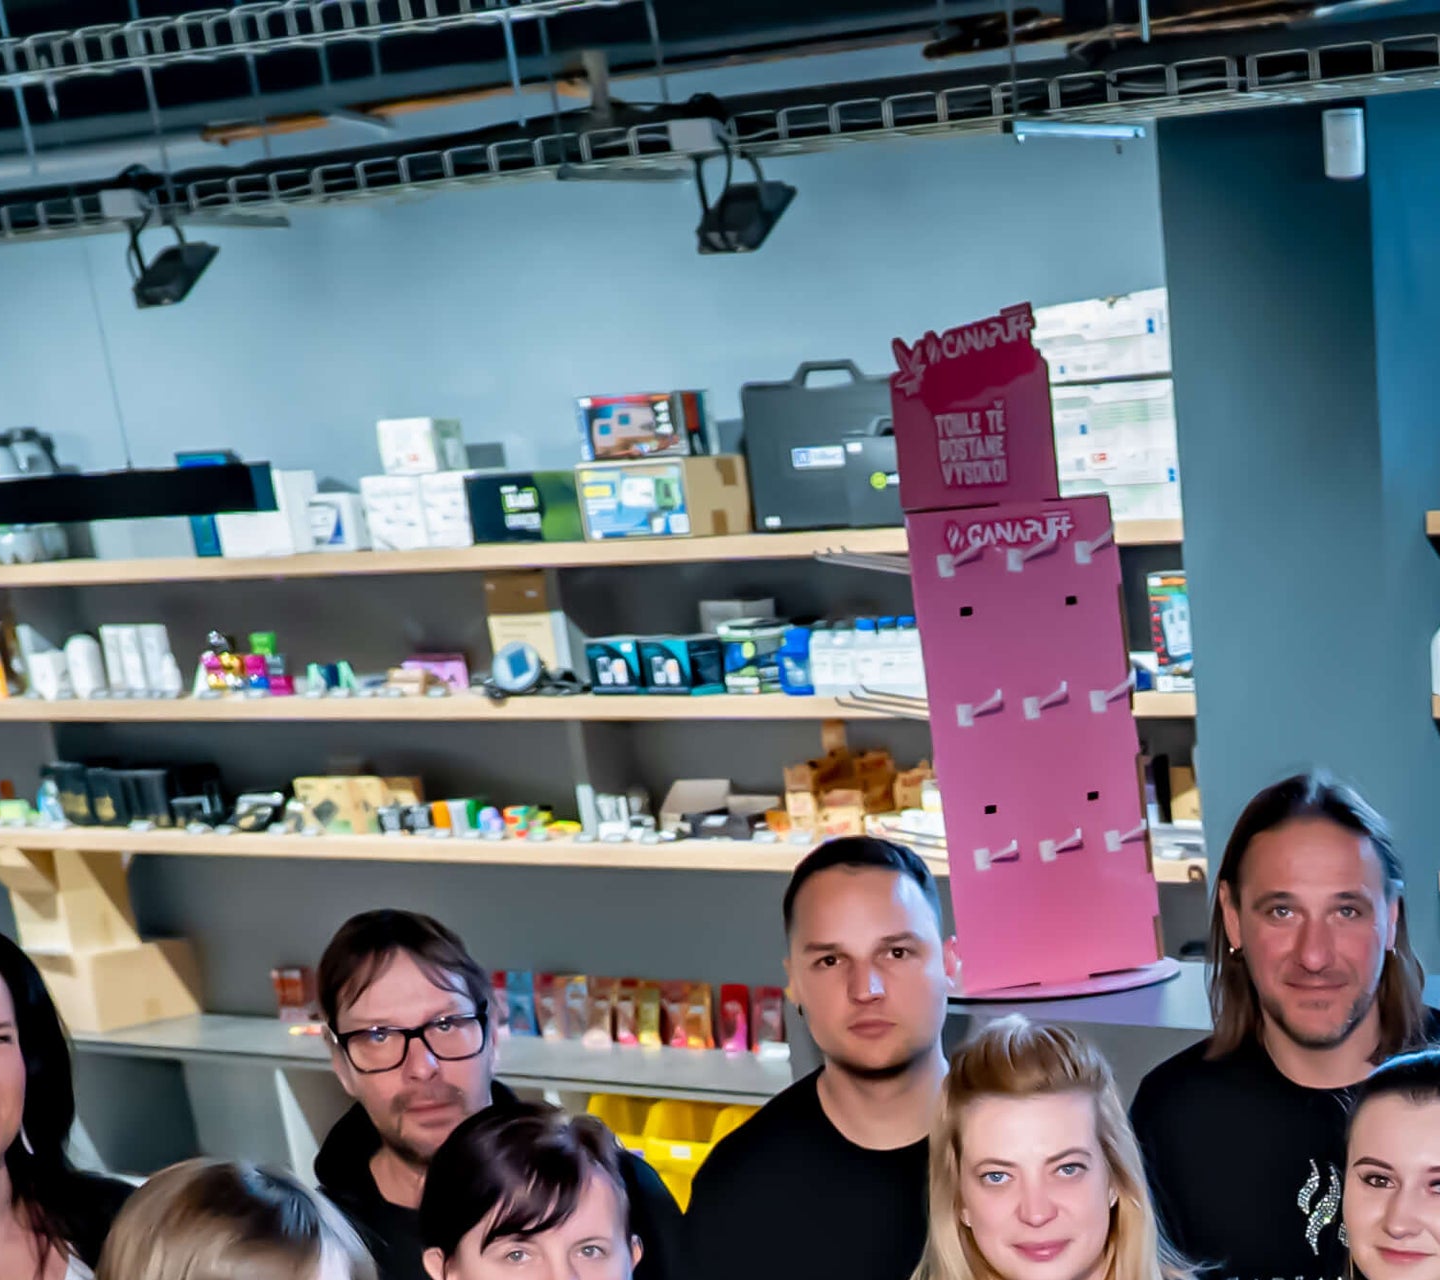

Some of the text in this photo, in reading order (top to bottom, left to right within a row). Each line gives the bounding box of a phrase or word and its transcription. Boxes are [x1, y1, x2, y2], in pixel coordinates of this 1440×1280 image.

[941, 312, 1032, 359] CANAPUFF
[935, 412, 981, 437] TOHLE
[938, 434, 1006, 463] DOSTANE
[967, 515, 1075, 546] CANAPUFF
